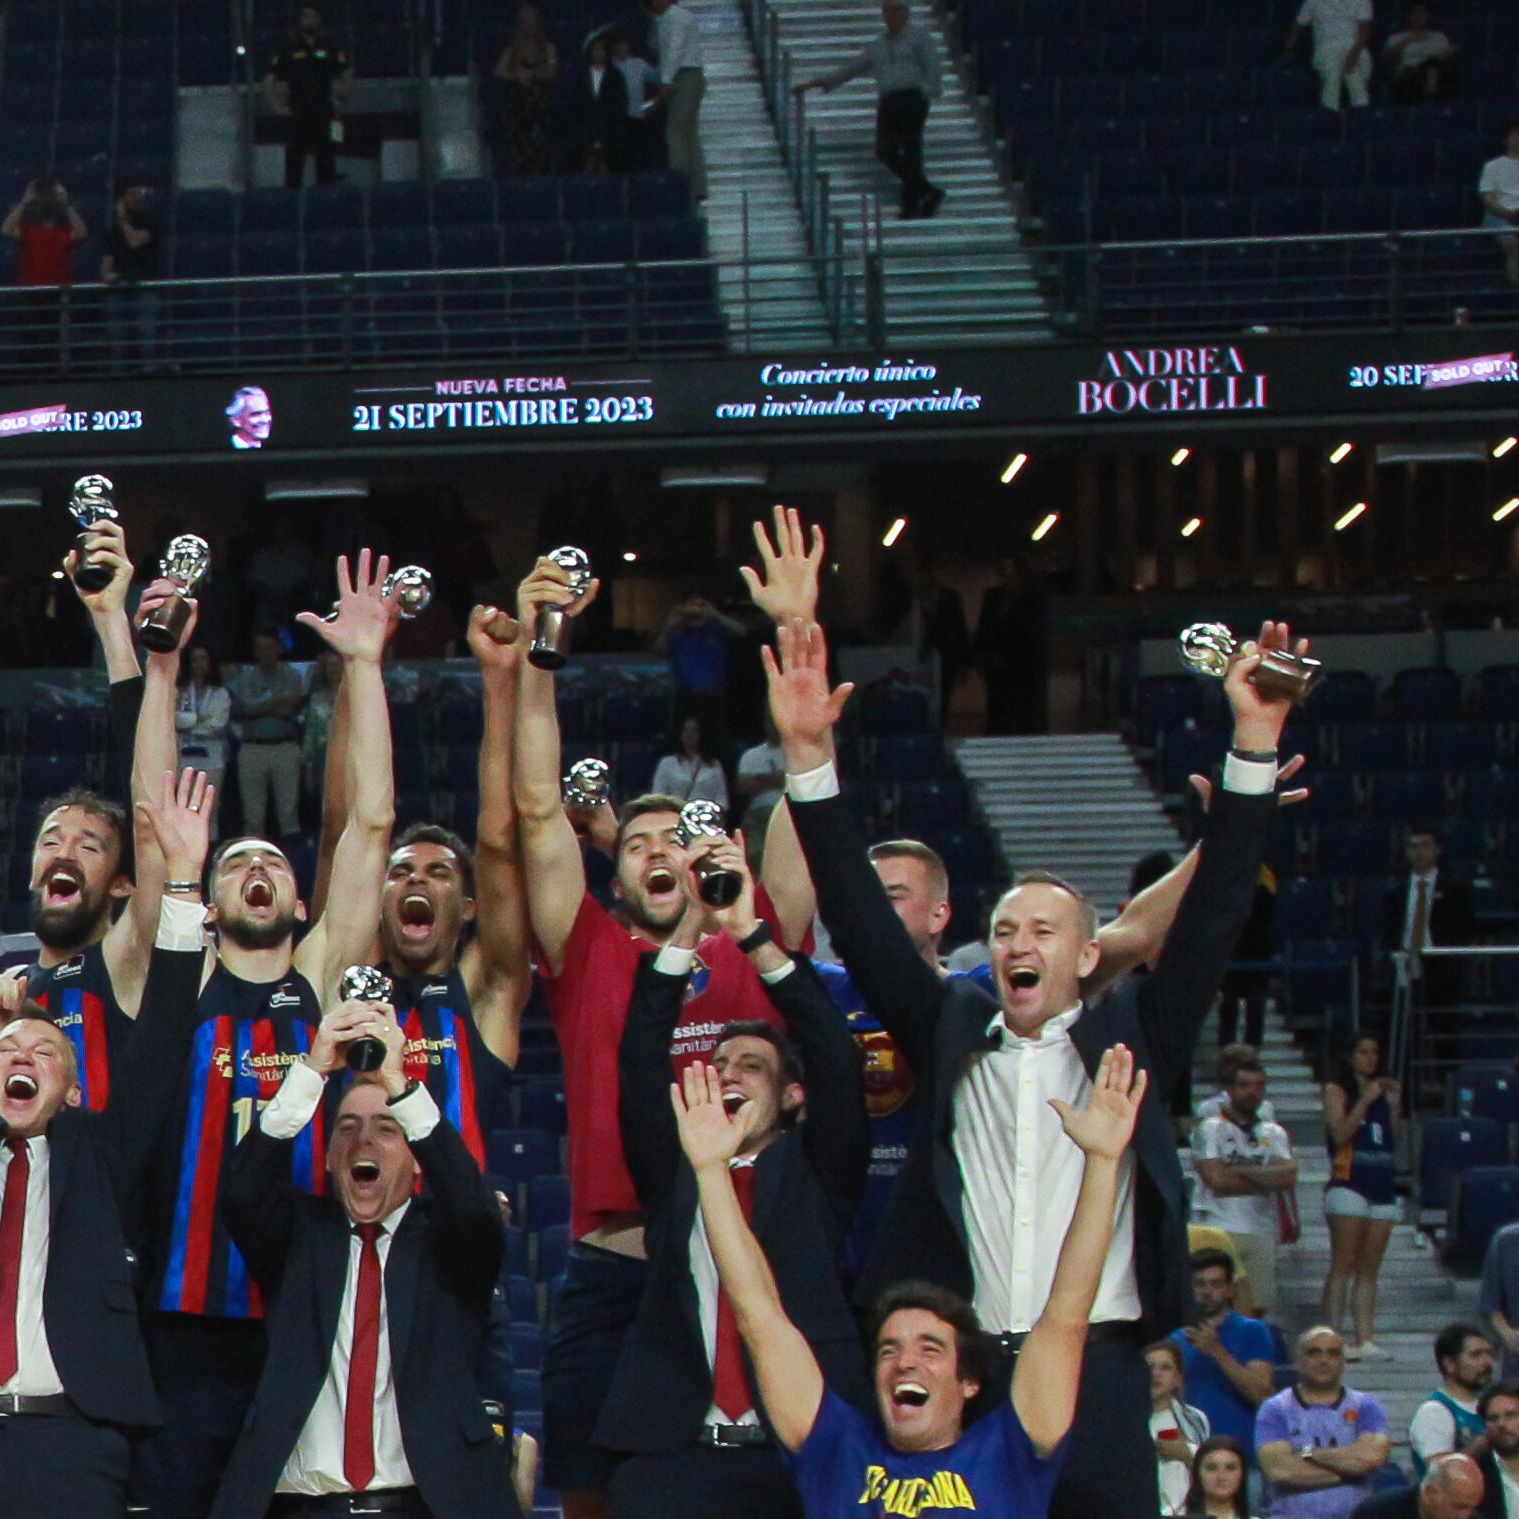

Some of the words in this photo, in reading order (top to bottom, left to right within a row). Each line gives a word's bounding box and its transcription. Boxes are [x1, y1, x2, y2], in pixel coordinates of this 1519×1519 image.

[762, 363, 868, 386] Concierto
[874, 362, 936, 383] único
[1098, 347, 1245, 377] ANDREA
[1432, 368, 1469, 383] SOLD
[1472, 360, 1502, 377] OUT
[436, 380, 499, 396] NUEVA
[504, 377, 566, 394] FECHA
[1350, 365, 1378, 389] 20
[716, 399, 756, 419] con
[761, 393, 865, 417] invitados
[870, 390, 981, 420] especiales
[1078, 375, 1267, 415] BOCELLI
[91, 410, 142, 432] 2023
[353, 406, 382, 432] 21
[388, 399, 579, 430] SEPTIEMBRE
[584, 397, 654, 425] 2023
